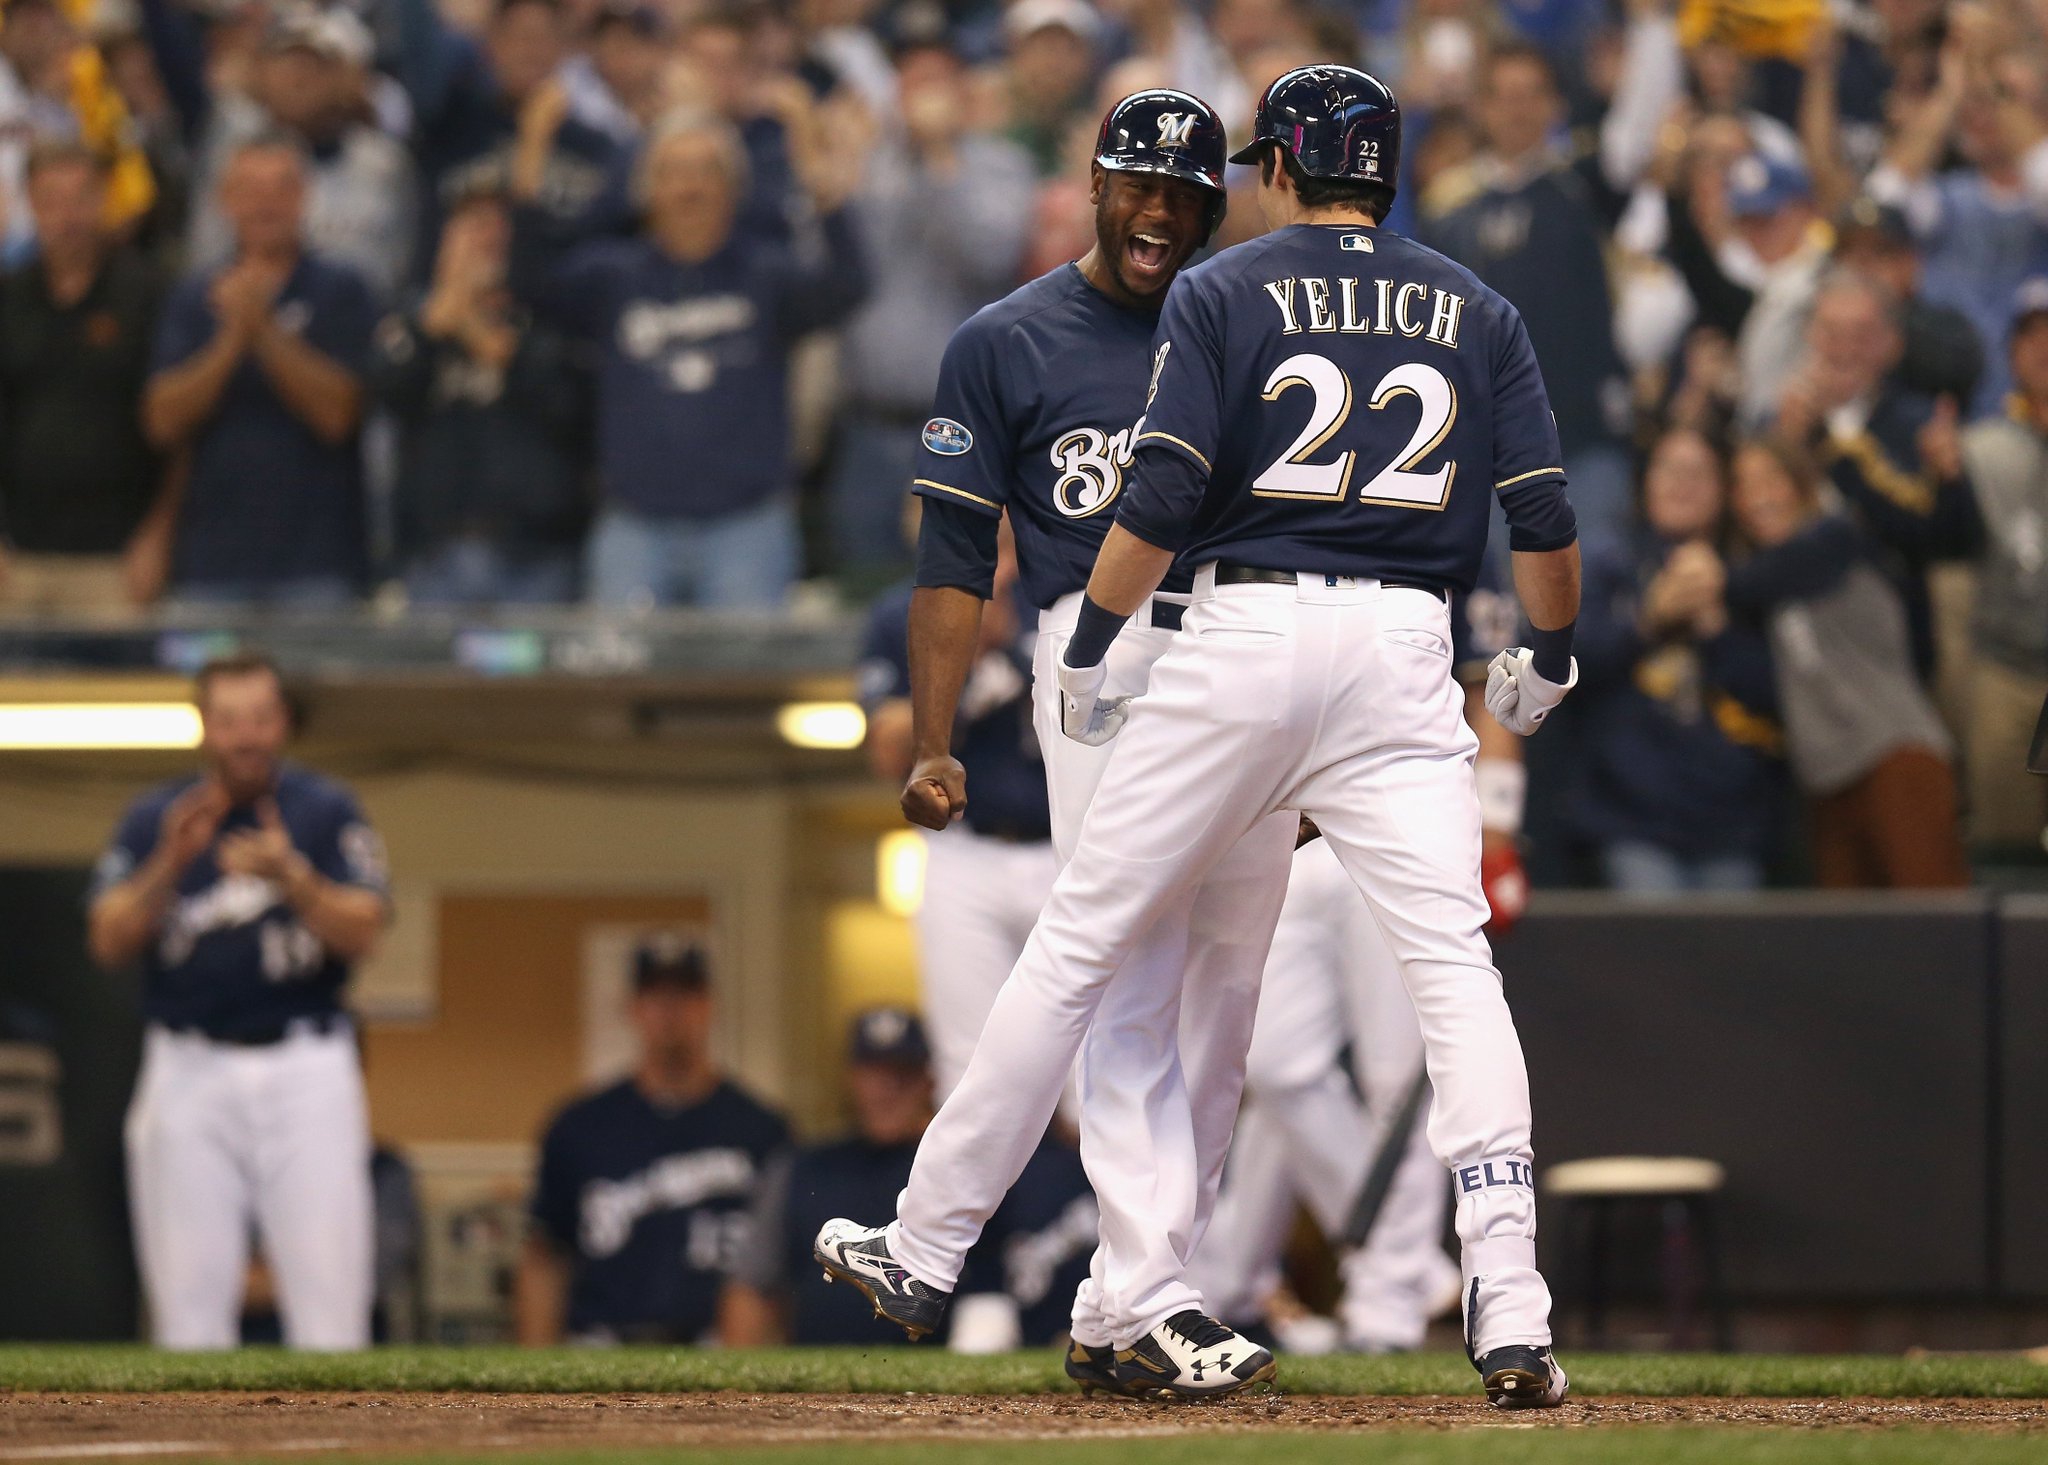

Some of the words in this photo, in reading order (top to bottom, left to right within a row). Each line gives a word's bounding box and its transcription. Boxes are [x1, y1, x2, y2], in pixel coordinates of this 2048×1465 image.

[1156, 111, 1198, 149] M
[1359, 140, 1379, 158] 22
[1263, 276, 1465, 349] YELICH
[1251, 352, 1459, 512] 22
[1452, 1160, 1533, 1199] ELIC
